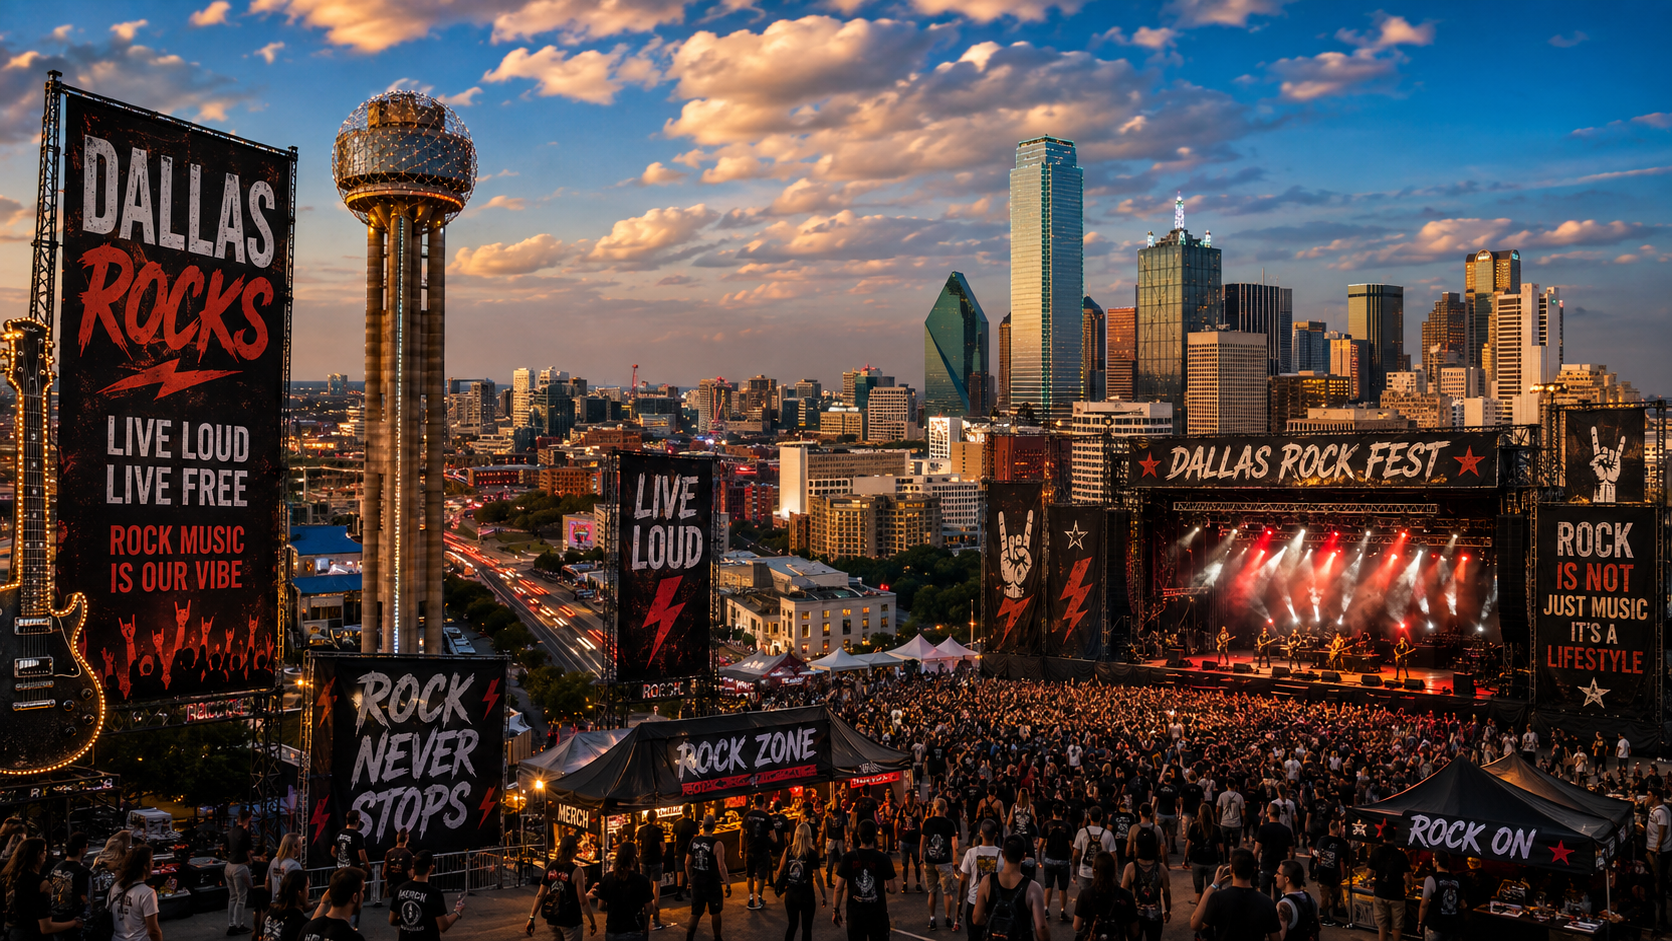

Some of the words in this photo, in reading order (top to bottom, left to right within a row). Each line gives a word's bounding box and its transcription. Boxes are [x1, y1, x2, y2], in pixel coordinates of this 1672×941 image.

[82, 134, 275, 268] DALLAS
[77, 242, 274, 363] ROCKS
[107, 415, 172, 458] LIVE
[182, 421, 250, 463] LOUD
[1165, 444, 1271, 481] DALLAS
[1278, 442, 1360, 484] ROCK
[1365, 440, 1451, 482] FEST
[106, 464, 172, 505] LIVE
[182, 467, 248, 507] FREE
[634, 472, 699, 520] LIVE
[110, 525, 173, 555] ROCK
[180, 525, 245, 555] MUSIC
[631, 524, 703, 572] LOUD
[1557, 521, 1635, 559] ROCK
[110, 562, 133, 593] IS
[142, 561, 188, 592] OUR
[195, 560, 243, 590] VIBE
[1556, 562, 1578, 590] IS
[1586, 562, 1635, 593] NOT
[1543, 594, 1587, 617] JUST
[1591, 596, 1648, 621] MUSIC
[1571, 621, 1602, 643] IT'S
[1606, 623, 1618, 644] A
[1547, 645, 1644, 674] LIFESTYLE
[355, 670, 475, 737] ROCK
[351, 725, 480, 791] NEVER
[675, 734, 748, 782] ROCK
[754, 726, 817, 769] ZONE
[351, 781, 472, 844] STOPS
[558, 803, 589, 829] MERCH
[1407, 814, 1486, 855] ROCK
[1491, 826, 1537, 859] ON
